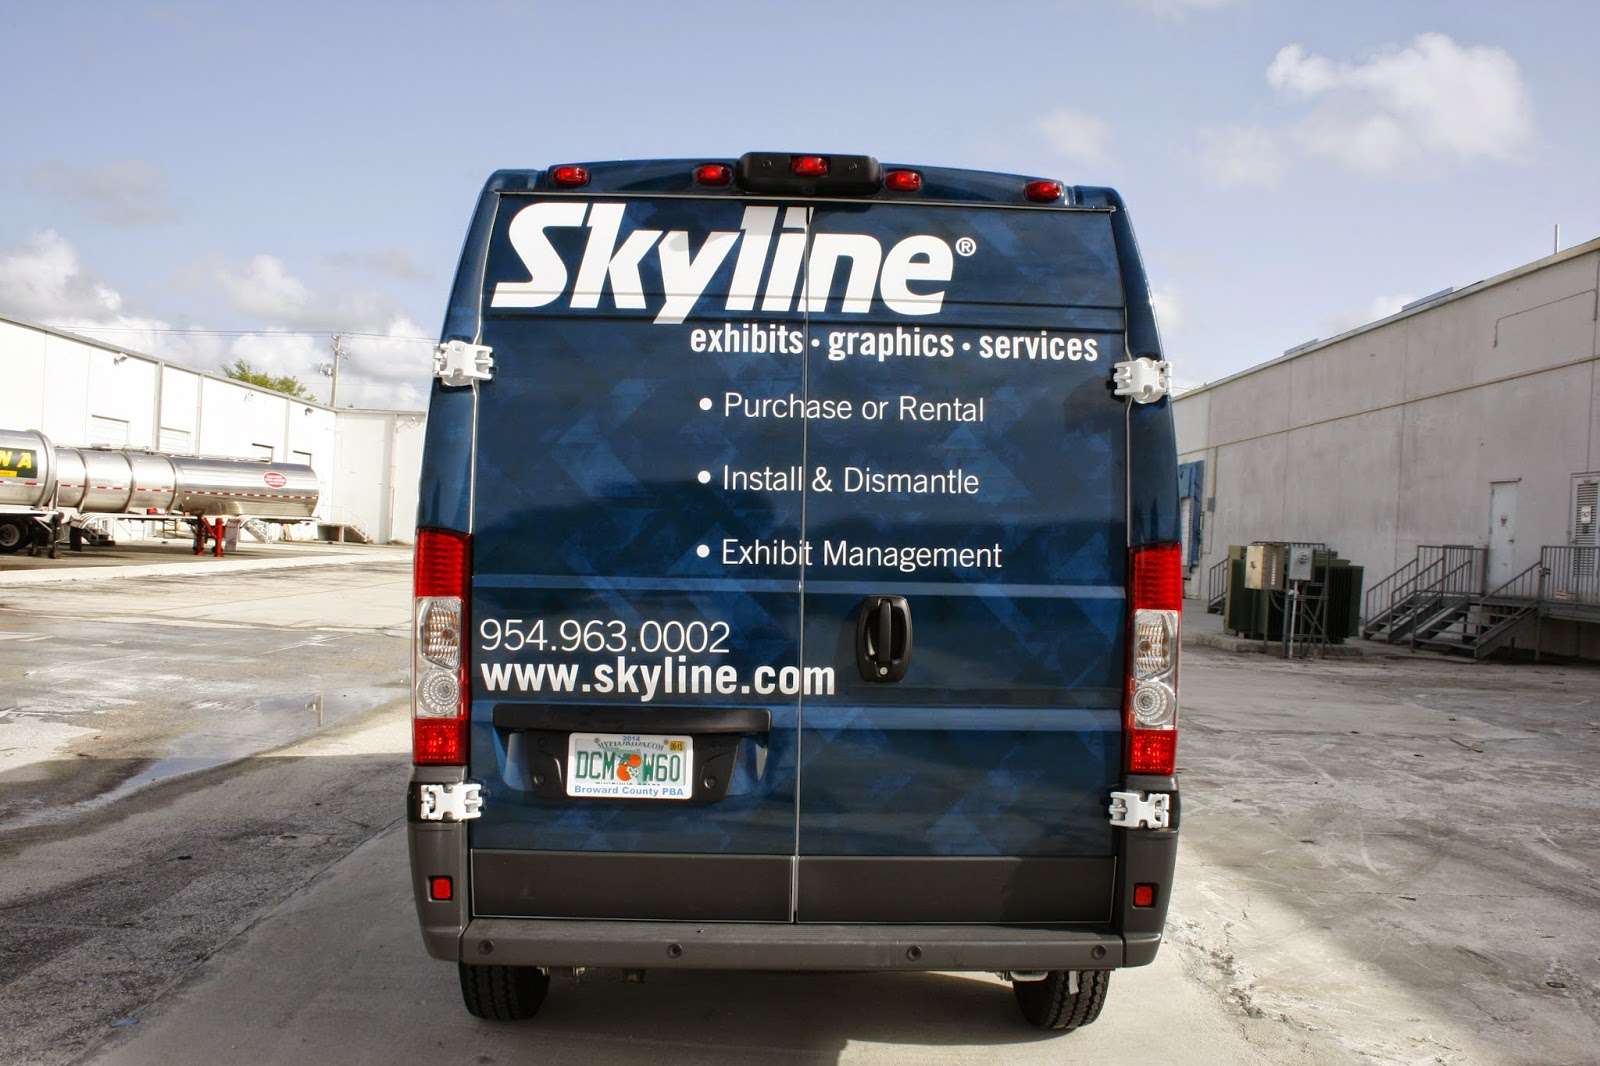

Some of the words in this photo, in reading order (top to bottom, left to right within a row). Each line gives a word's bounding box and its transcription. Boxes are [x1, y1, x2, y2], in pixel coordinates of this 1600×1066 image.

[690, 323, 804, 355] exhibits
[827, 327, 955, 363] graphics
[979, 331, 1098, 362] services
[724, 392, 853, 420] Purchase
[861, 401, 890, 421] or
[899, 396, 985, 422] Rental
[723, 465, 804, 492] Install
[811, 467, 833, 493] &
[844, 467, 980, 495] Dismantle
[721, 538, 813, 566] Exhibit
[822, 540, 1003, 572] Management
[480, 618, 730, 654] 954.963.0002
[480, 655, 836, 702] www.skyline.com
[575, 750, 617, 780] DCM
[642, 753, 681, 782] W60
[574, 785, 619, 795] Broward
[621, 787, 659, 797] County
[661, 788, 685, 796] PBA
